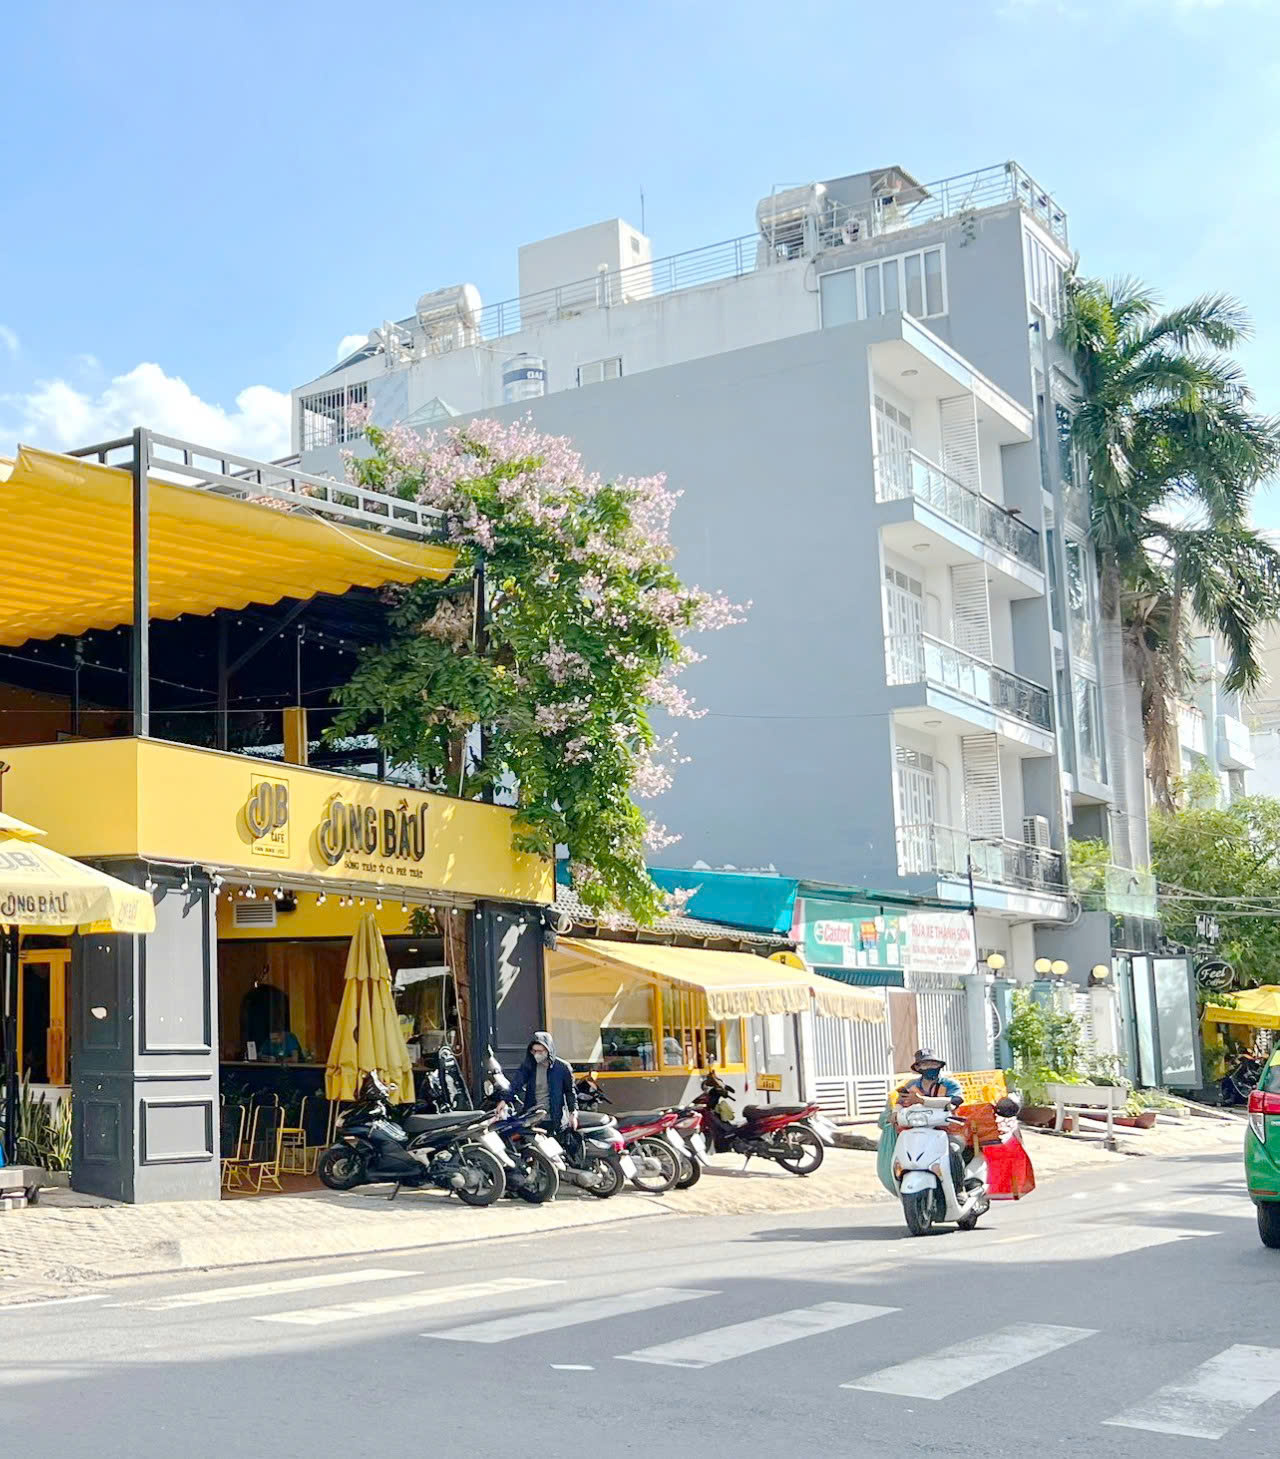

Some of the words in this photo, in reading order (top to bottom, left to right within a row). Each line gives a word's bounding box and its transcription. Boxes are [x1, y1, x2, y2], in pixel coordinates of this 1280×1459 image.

[318, 791, 377, 867] ÔNG
[379, 797, 429, 862] BẦU
[0, 891, 35, 917] ÔNG
[38, 889, 69, 913] BẦU
[825, 922, 850, 944] Castrol
[1200, 966, 1227, 980] Feel
